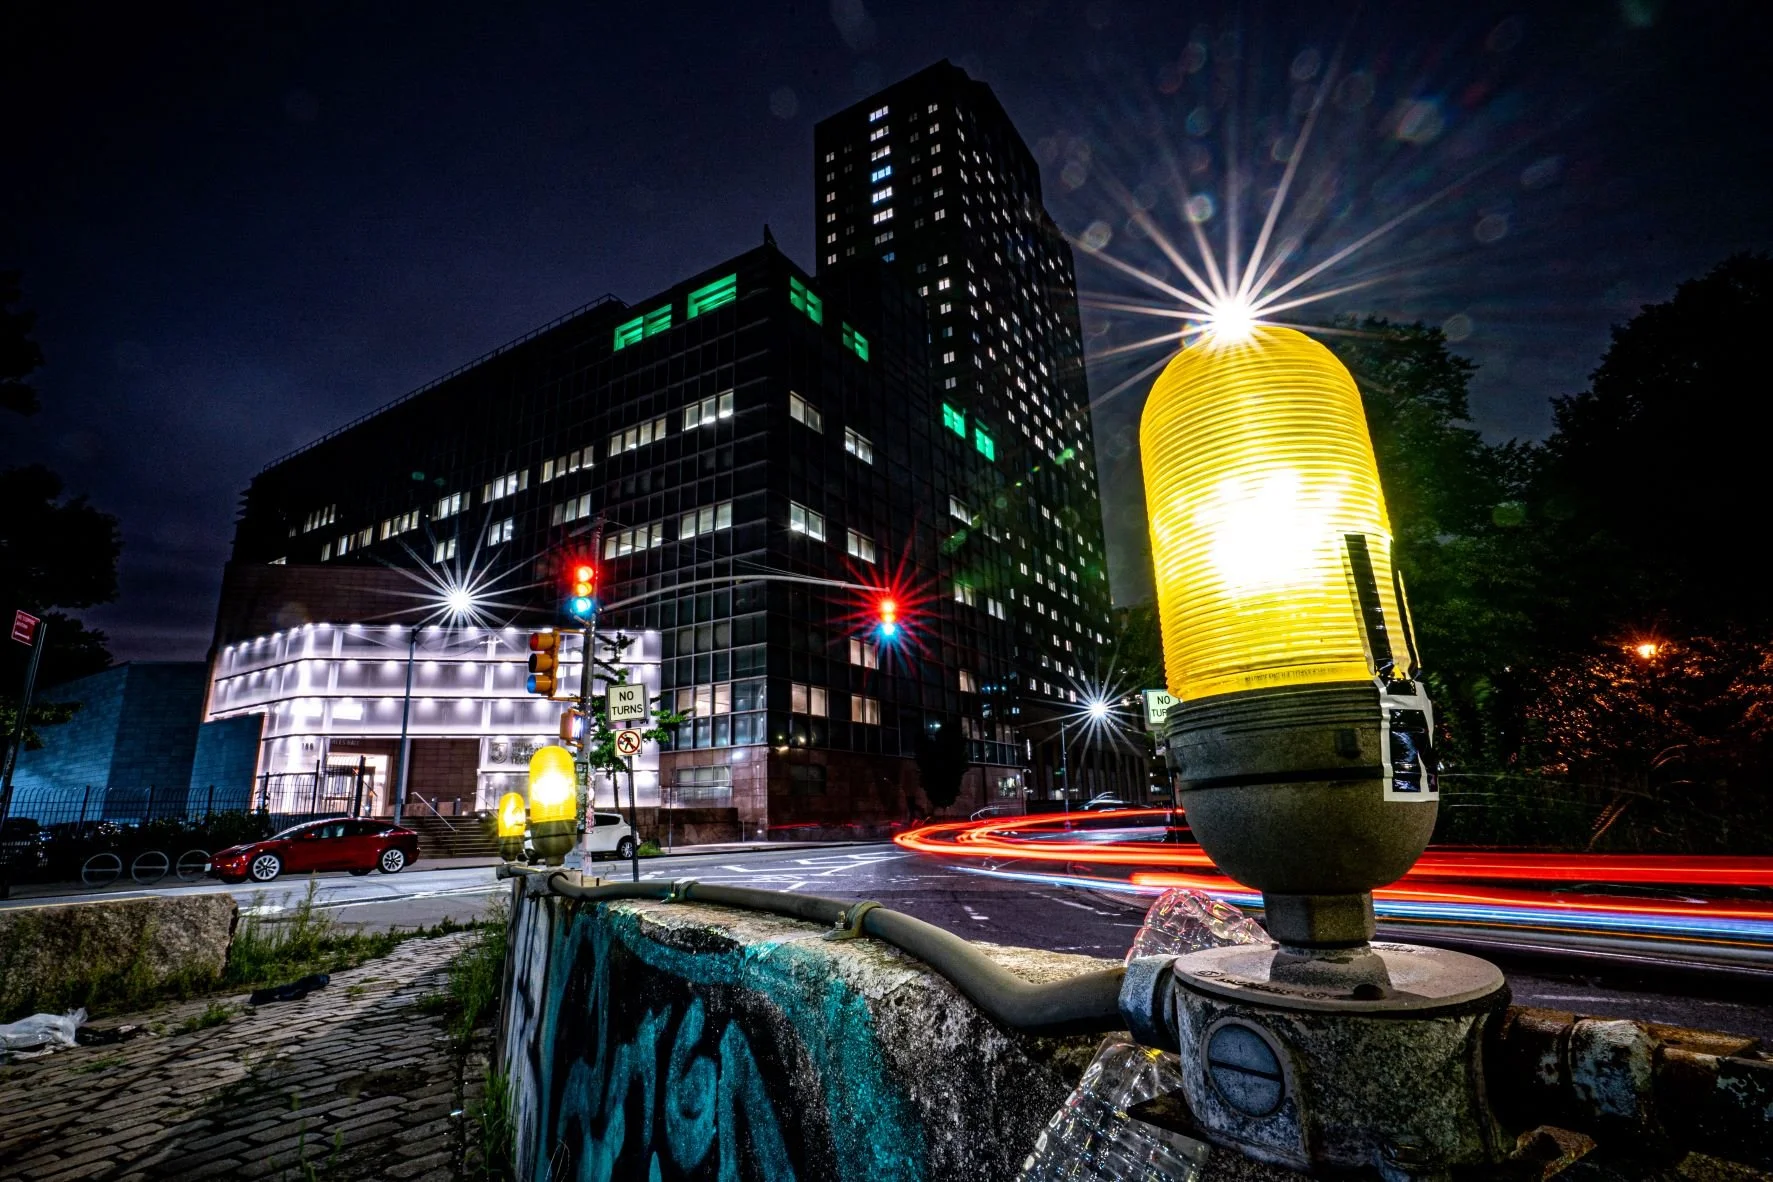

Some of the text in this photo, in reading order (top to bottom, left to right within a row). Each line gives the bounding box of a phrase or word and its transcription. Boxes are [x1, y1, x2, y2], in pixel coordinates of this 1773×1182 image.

[619, 691, 634, 701] NO
[1157, 696, 1171, 705] NO
[612, 704, 643, 715] TURNS
[1152, 709, 1168, 718] TUR
